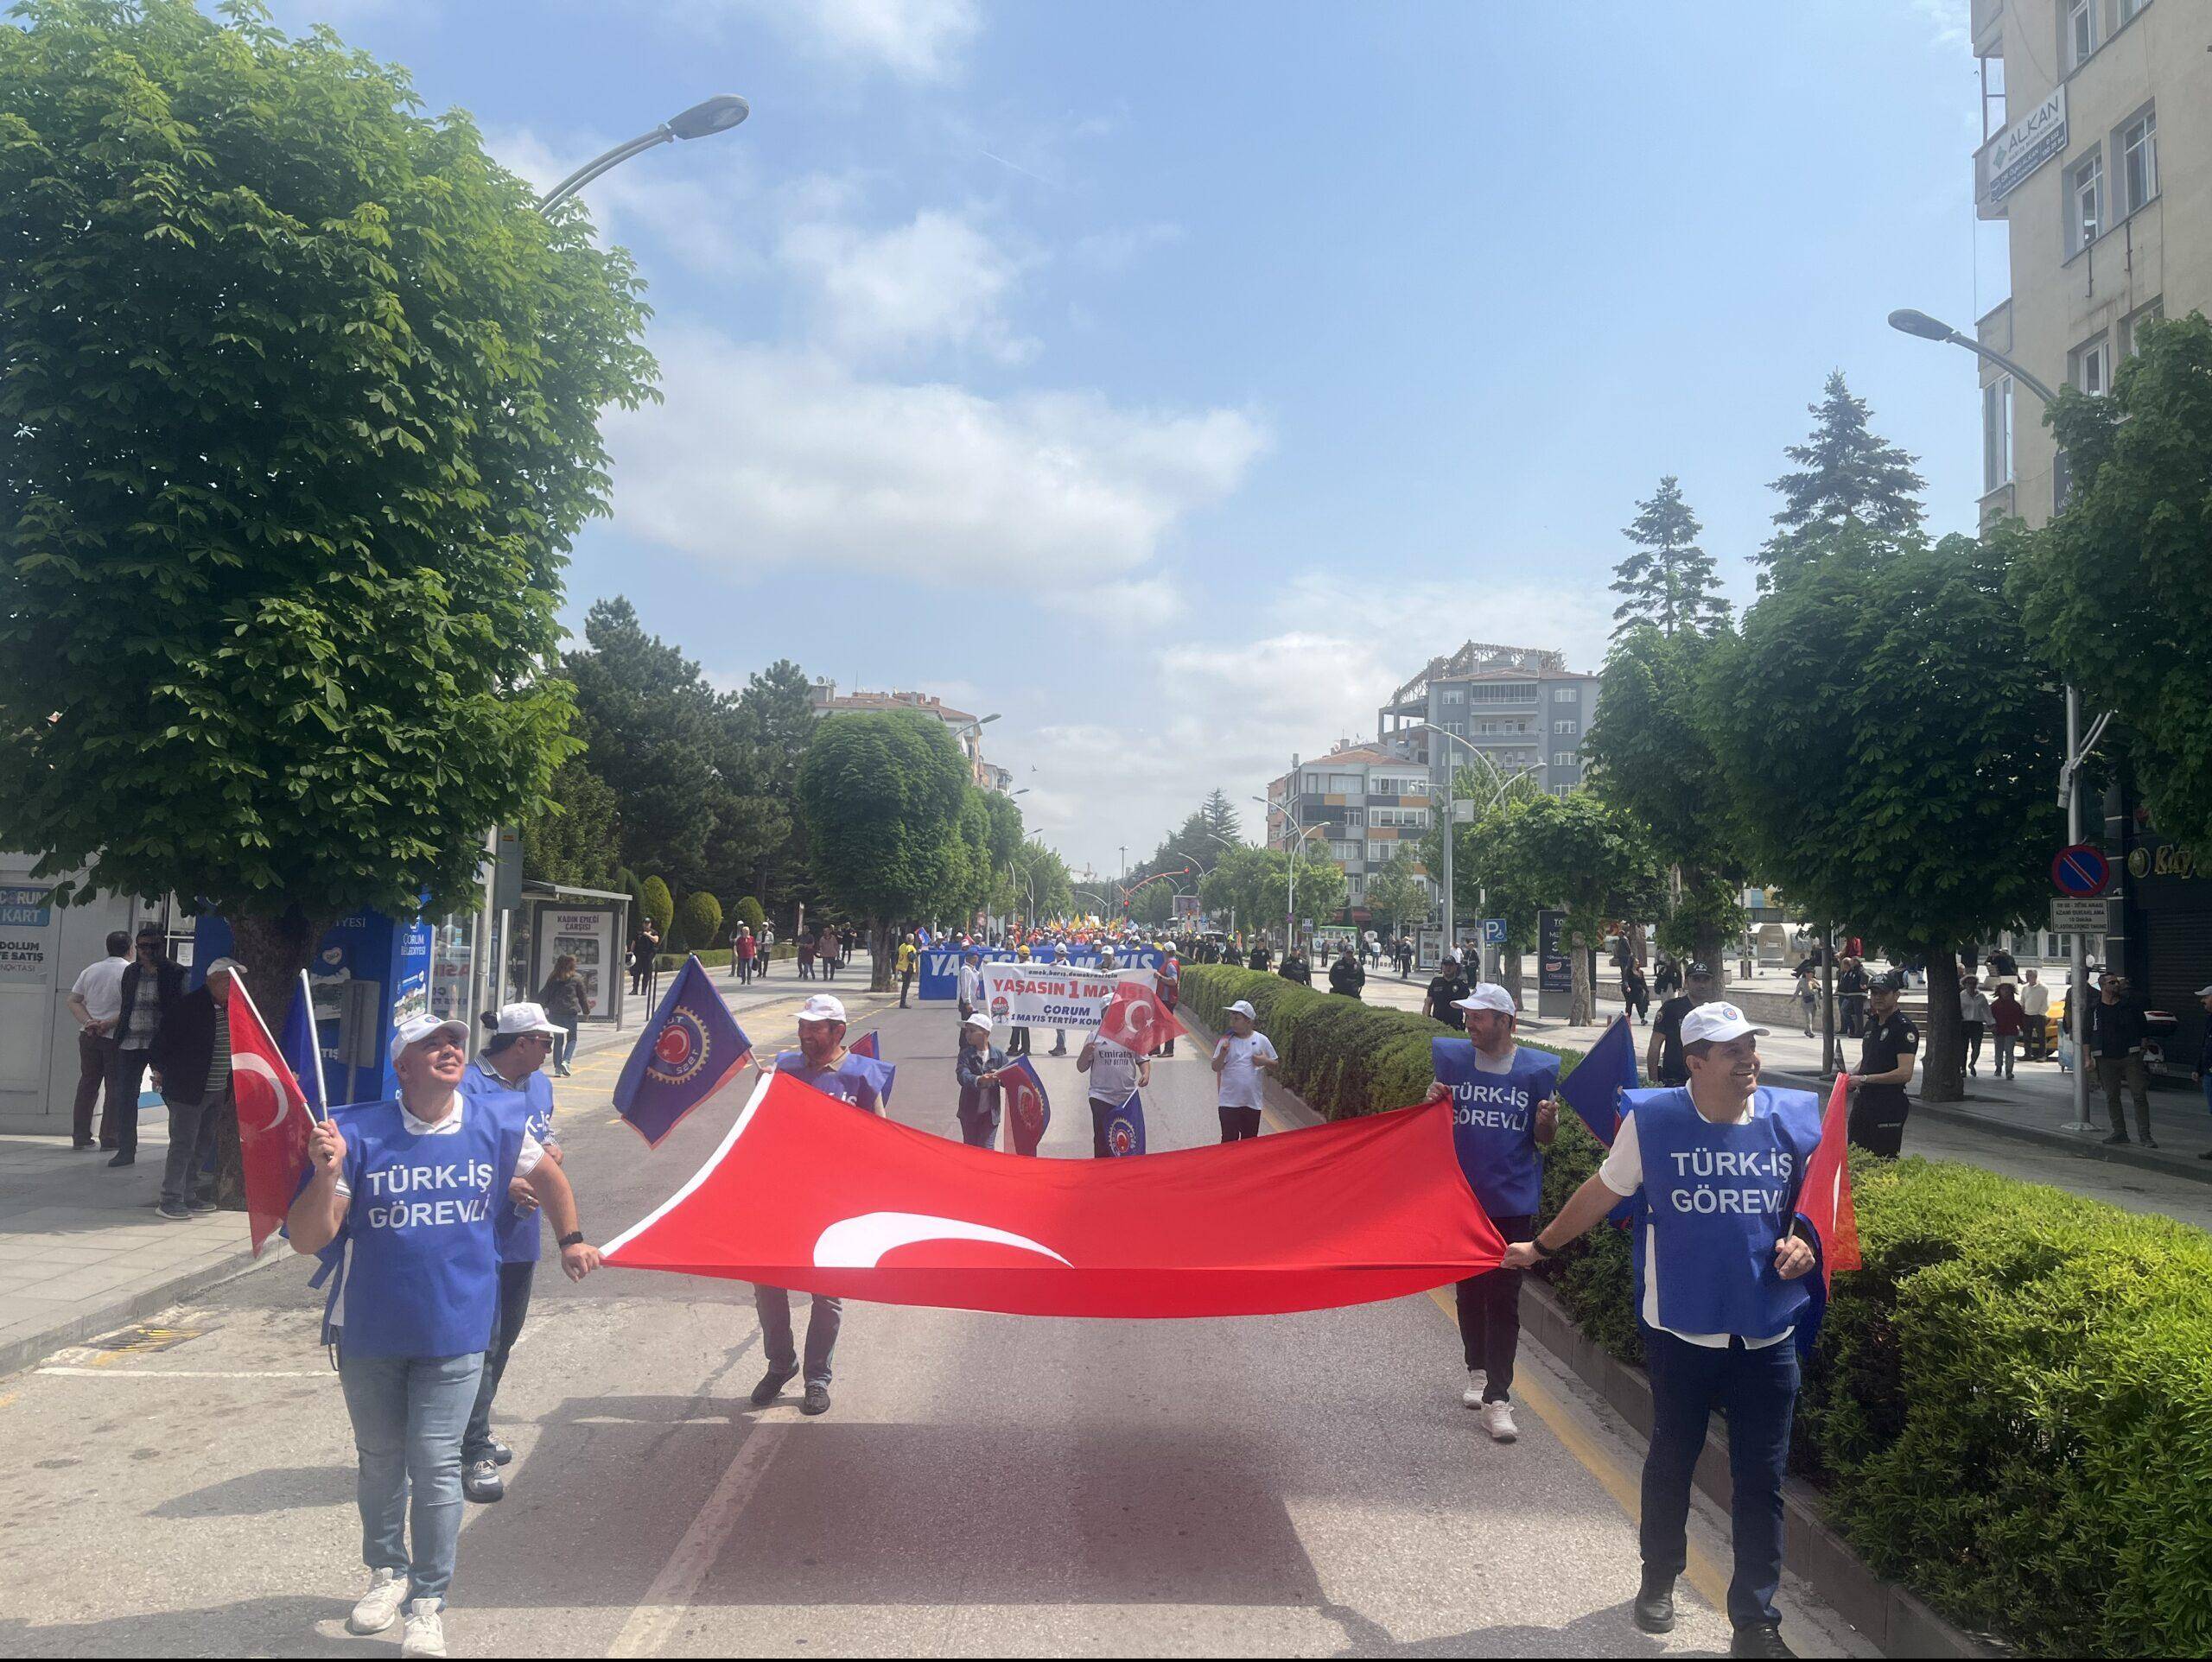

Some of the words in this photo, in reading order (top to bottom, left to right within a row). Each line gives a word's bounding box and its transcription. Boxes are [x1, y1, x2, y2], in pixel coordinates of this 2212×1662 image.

[2009, 95, 2059, 152] ALKAN
[3, 908, 41, 923] KART
[0, 941, 40, 951] DOLUM
[403, 934, 423, 947] ÇORUM
[11, 952, 44, 962] SATIŞ
[993, 979, 1065, 995] YAŞASIN
[1068, 980, 1080, 999] 1
[1047, 1015, 1077, 1024] TERTİP
[1451, 1082, 1529, 1112] TÜRK-İŞ
[1452, 1106, 1529, 1132] GÖREVLİ
[1670, 1147, 1793, 1183] TÜRK-İŞ
[366, 1158, 493, 1196] TÜRK-İŞ
[368, 1193, 491, 1228] GÖREVLİ
